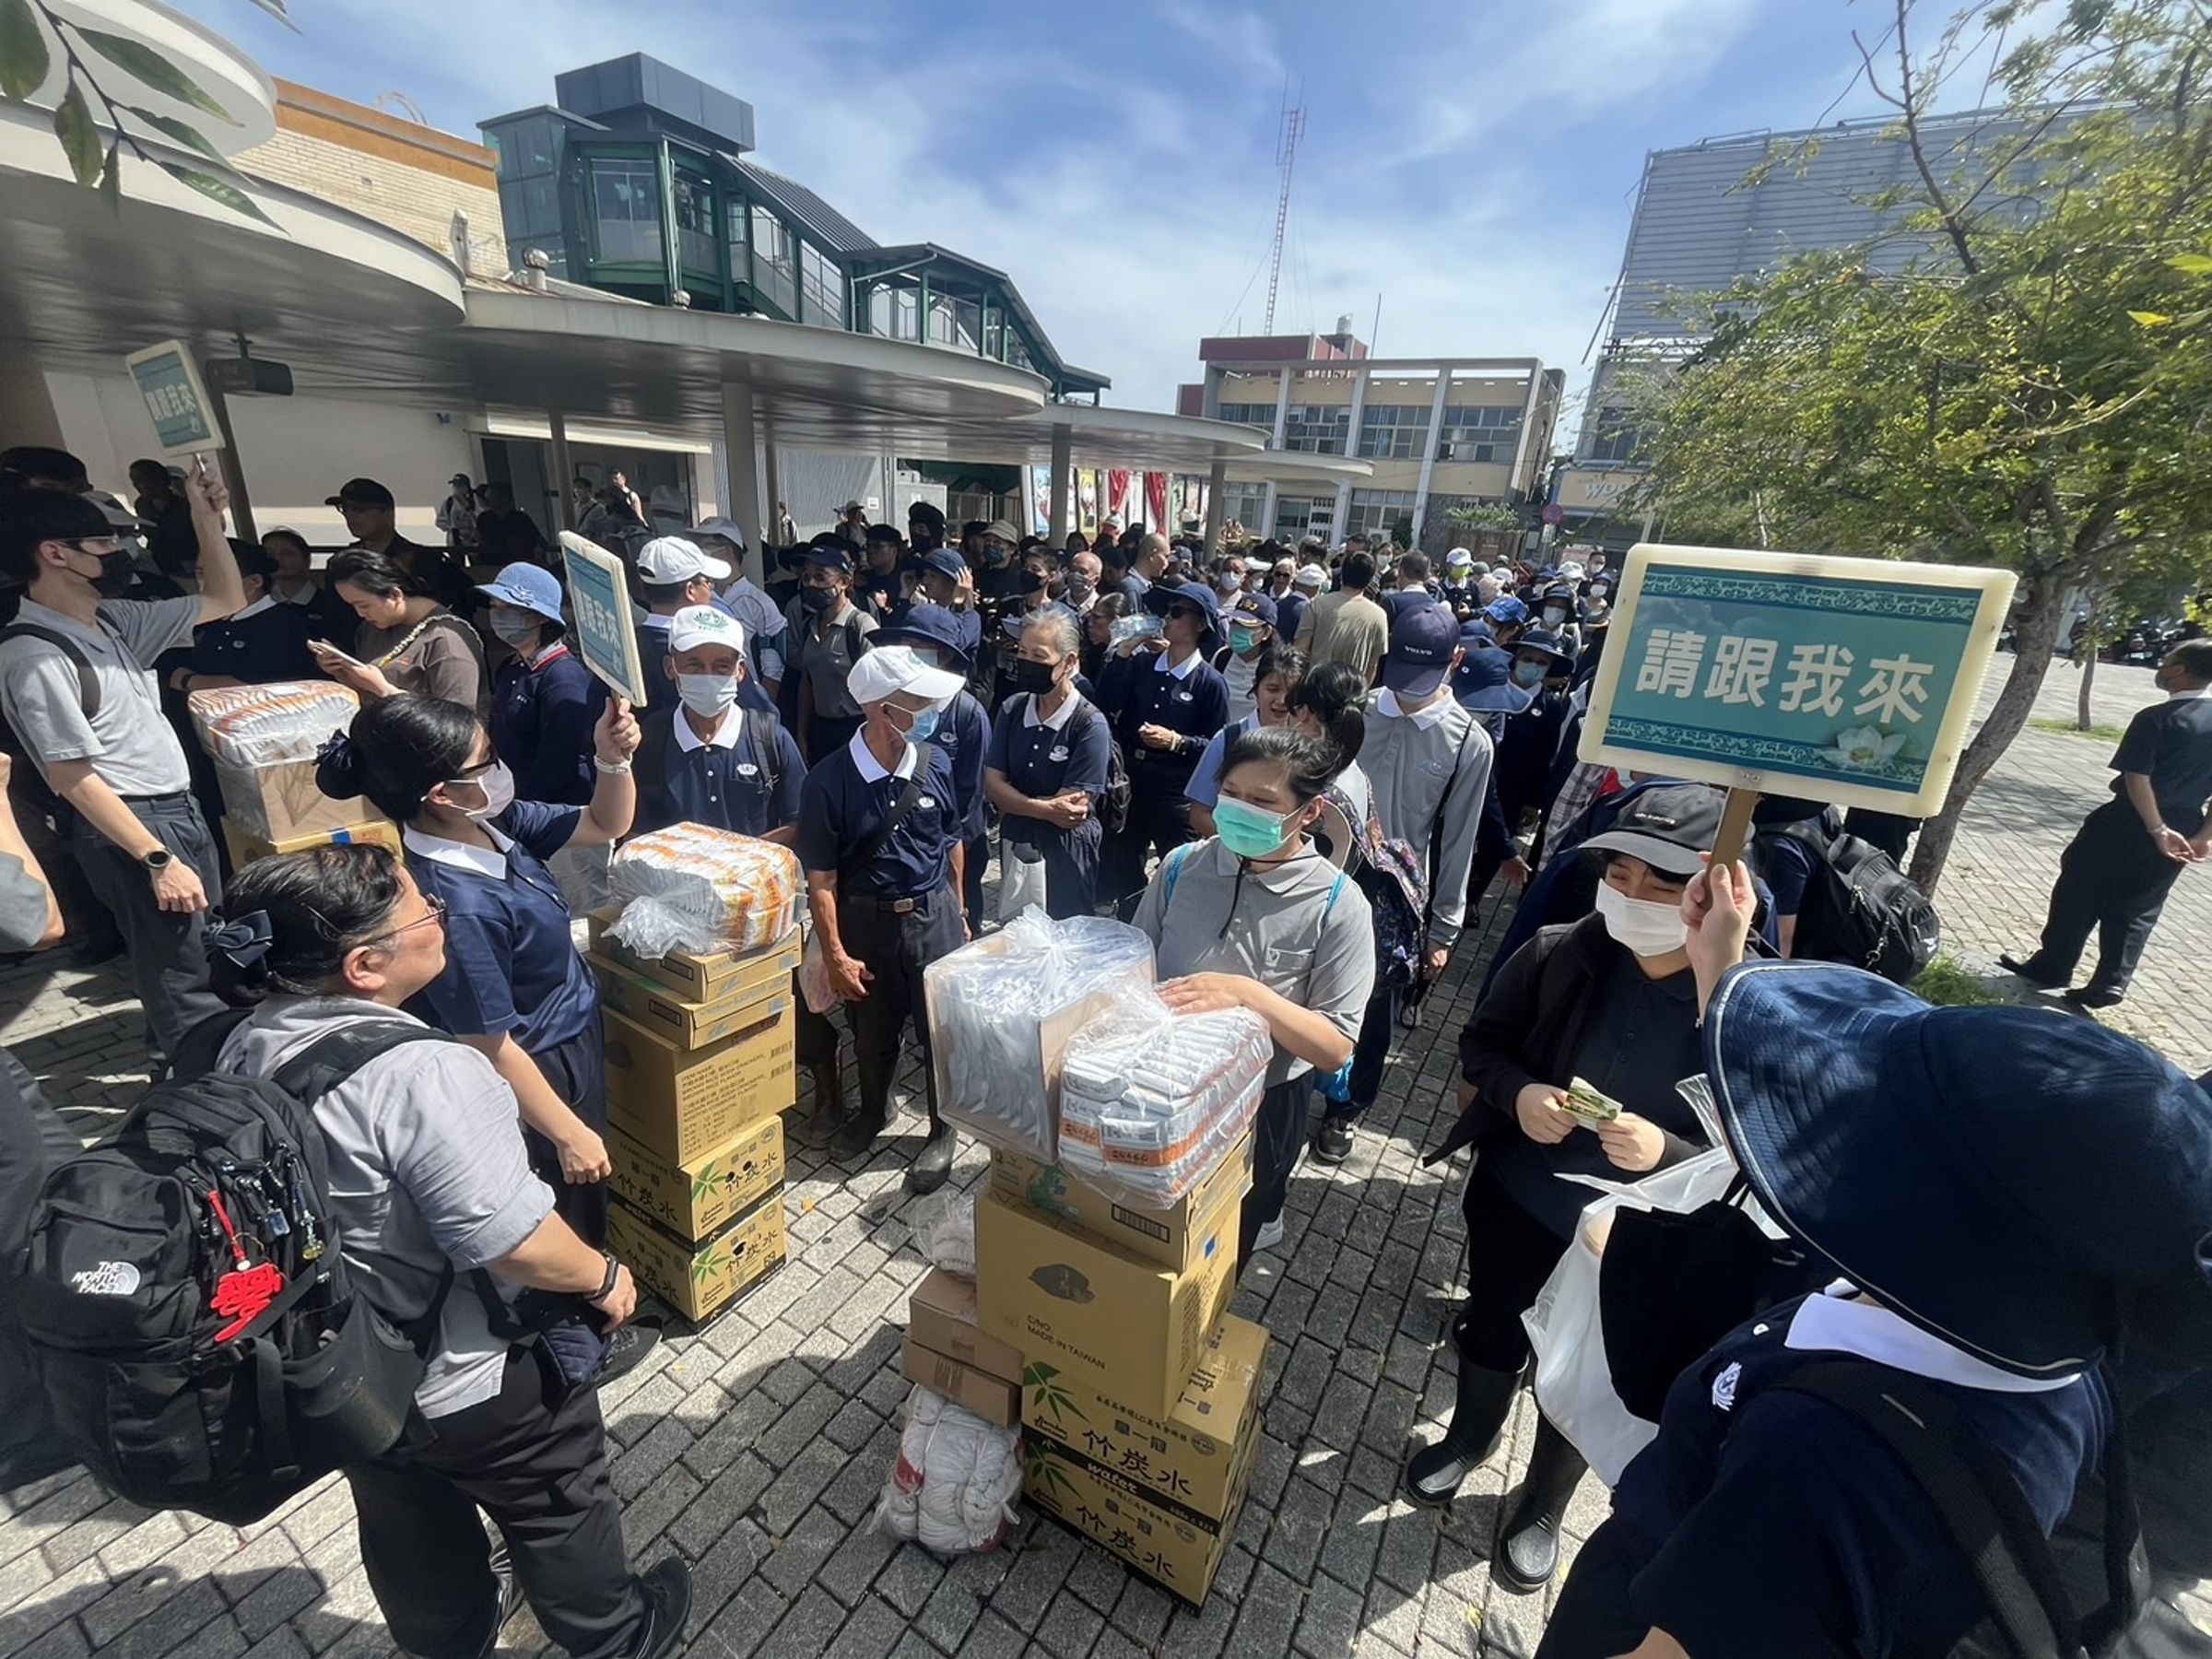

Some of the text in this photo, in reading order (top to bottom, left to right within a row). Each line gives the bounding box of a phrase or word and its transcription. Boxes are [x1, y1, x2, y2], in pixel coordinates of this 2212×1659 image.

[1634, 628, 1935, 724] 請跟我來
[71, 1271, 118, 1283] NORTH
[78, 1282, 114, 1294] FACE
[98, 1261, 122, 1273] THE
[1027, 1324, 1106, 1371] MADE IN TAIWAN
[1082, 1429, 1193, 1496] 竹炭水
[1076, 1504, 1176, 1579] 竹炭水
